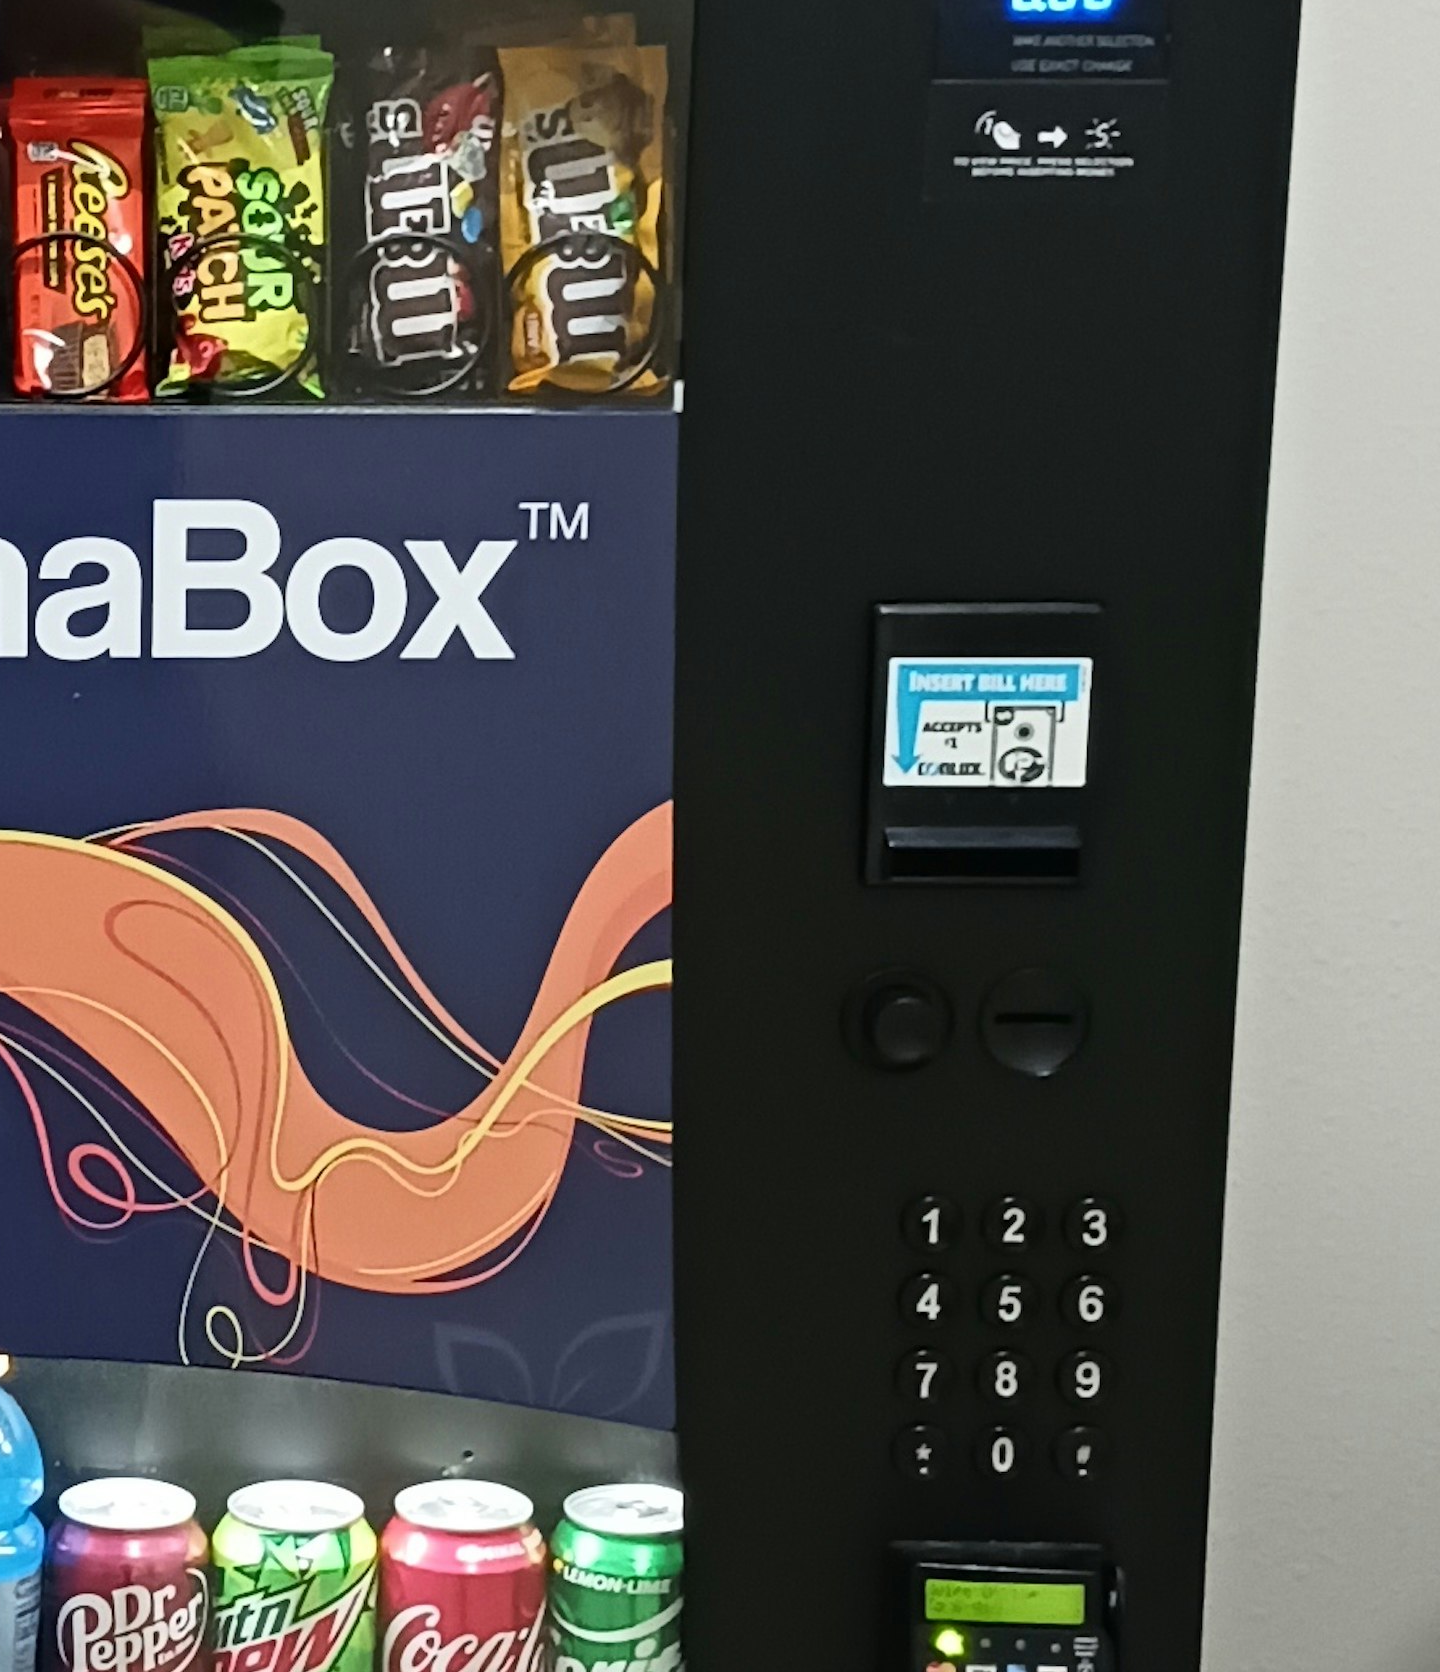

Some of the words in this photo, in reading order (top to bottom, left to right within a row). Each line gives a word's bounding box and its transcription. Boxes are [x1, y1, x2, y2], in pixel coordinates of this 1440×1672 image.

[187, 166, 247, 320] PATCH
[236, 170, 294, 307] SOUR
[518, 501, 591, 541] TM
[908, 670, 977, 692] INSERT
[978, 673, 1017, 692] BILL
[1020, 673, 1068, 692] HERE
[922, 722, 983, 732] ACCEPTS
[922, 1207, 940, 1244] 1
[1002, 1207, 1026, 1243] 2
[1082, 1209, 1107, 1246] 3
[916, 1283, 941, 1320] 4
[998, 1285, 1022, 1322] 5
[1078, 1285, 1104, 1322] 6
[916, 1362, 938, 1399] 7
[995, 1360, 1018, 1397] 8
[1075, 1361, 1101, 1398] 9
[991, 1436, 1014, 1472] 0
[563, 1565, 673, 1595] LEMON-LIME
[112, 1584, 176, 1636] Dr
